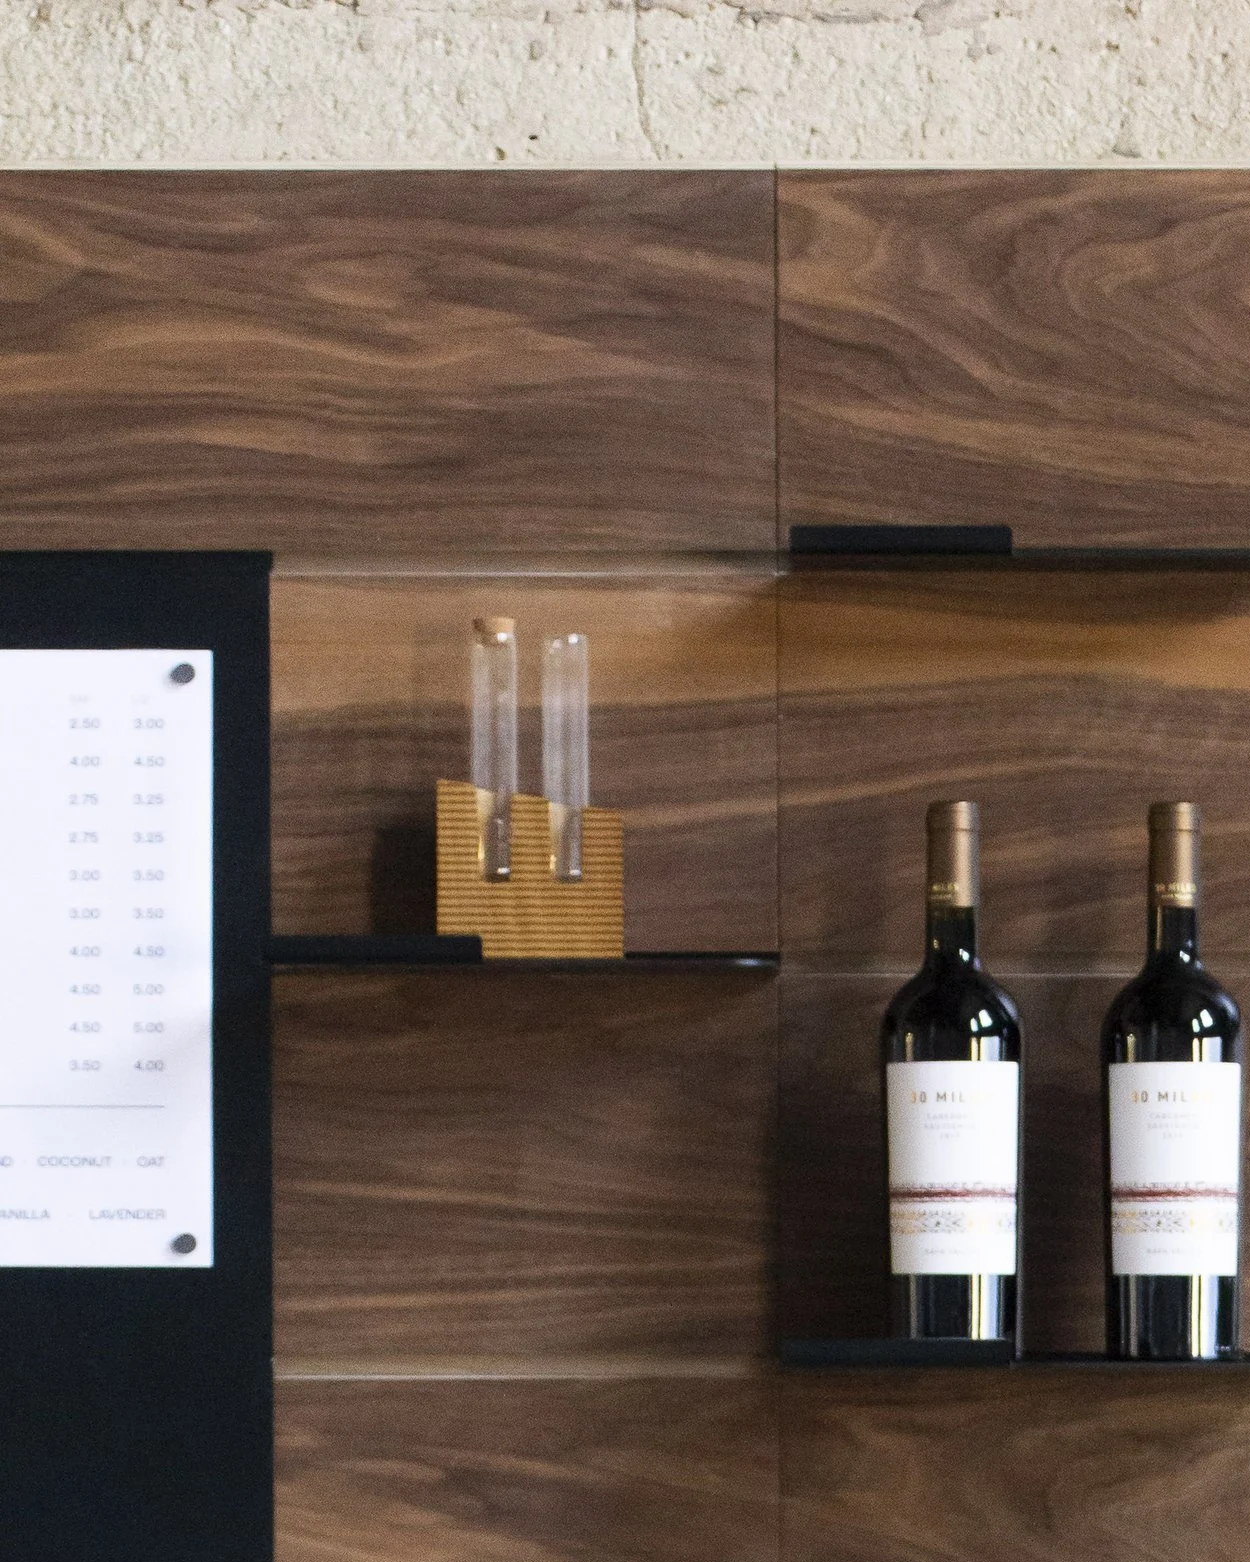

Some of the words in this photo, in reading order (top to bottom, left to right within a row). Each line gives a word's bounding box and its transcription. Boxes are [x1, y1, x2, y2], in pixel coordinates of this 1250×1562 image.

[69, 717, 101, 730] 2.50
[133, 717, 165, 730] 3.00
[69, 755, 101, 768] 4.00
[133, 755, 165, 768] 4.50
[69, 793, 101, 806] 2.75
[133, 793, 165, 806] 3.25
[69, 831, 101, 844] 2.75
[133, 831, 165, 844] 3.25
[133, 869, 165, 882] 3.50
[69, 907, 101, 921] 3.00
[133, 907, 165, 921] 3.50
[69, 945, 101, 958] 4.00
[133, 945, 165, 958] 4.50
[69, 983, 101, 996] 4.50
[133, 983, 165, 996] 5.00
[69, 1021, 101, 1034] 4.50
[133, 1021, 165, 1034] 5.00
[69, 1059, 101, 1073] 3.50
[133, 1059, 165, 1073] 4.00
[37, 1155, 112, 1168] COCONUT
[136, 1155, 166, 1168] OAT
[89, 1208, 167, 1221] LAVENDER
